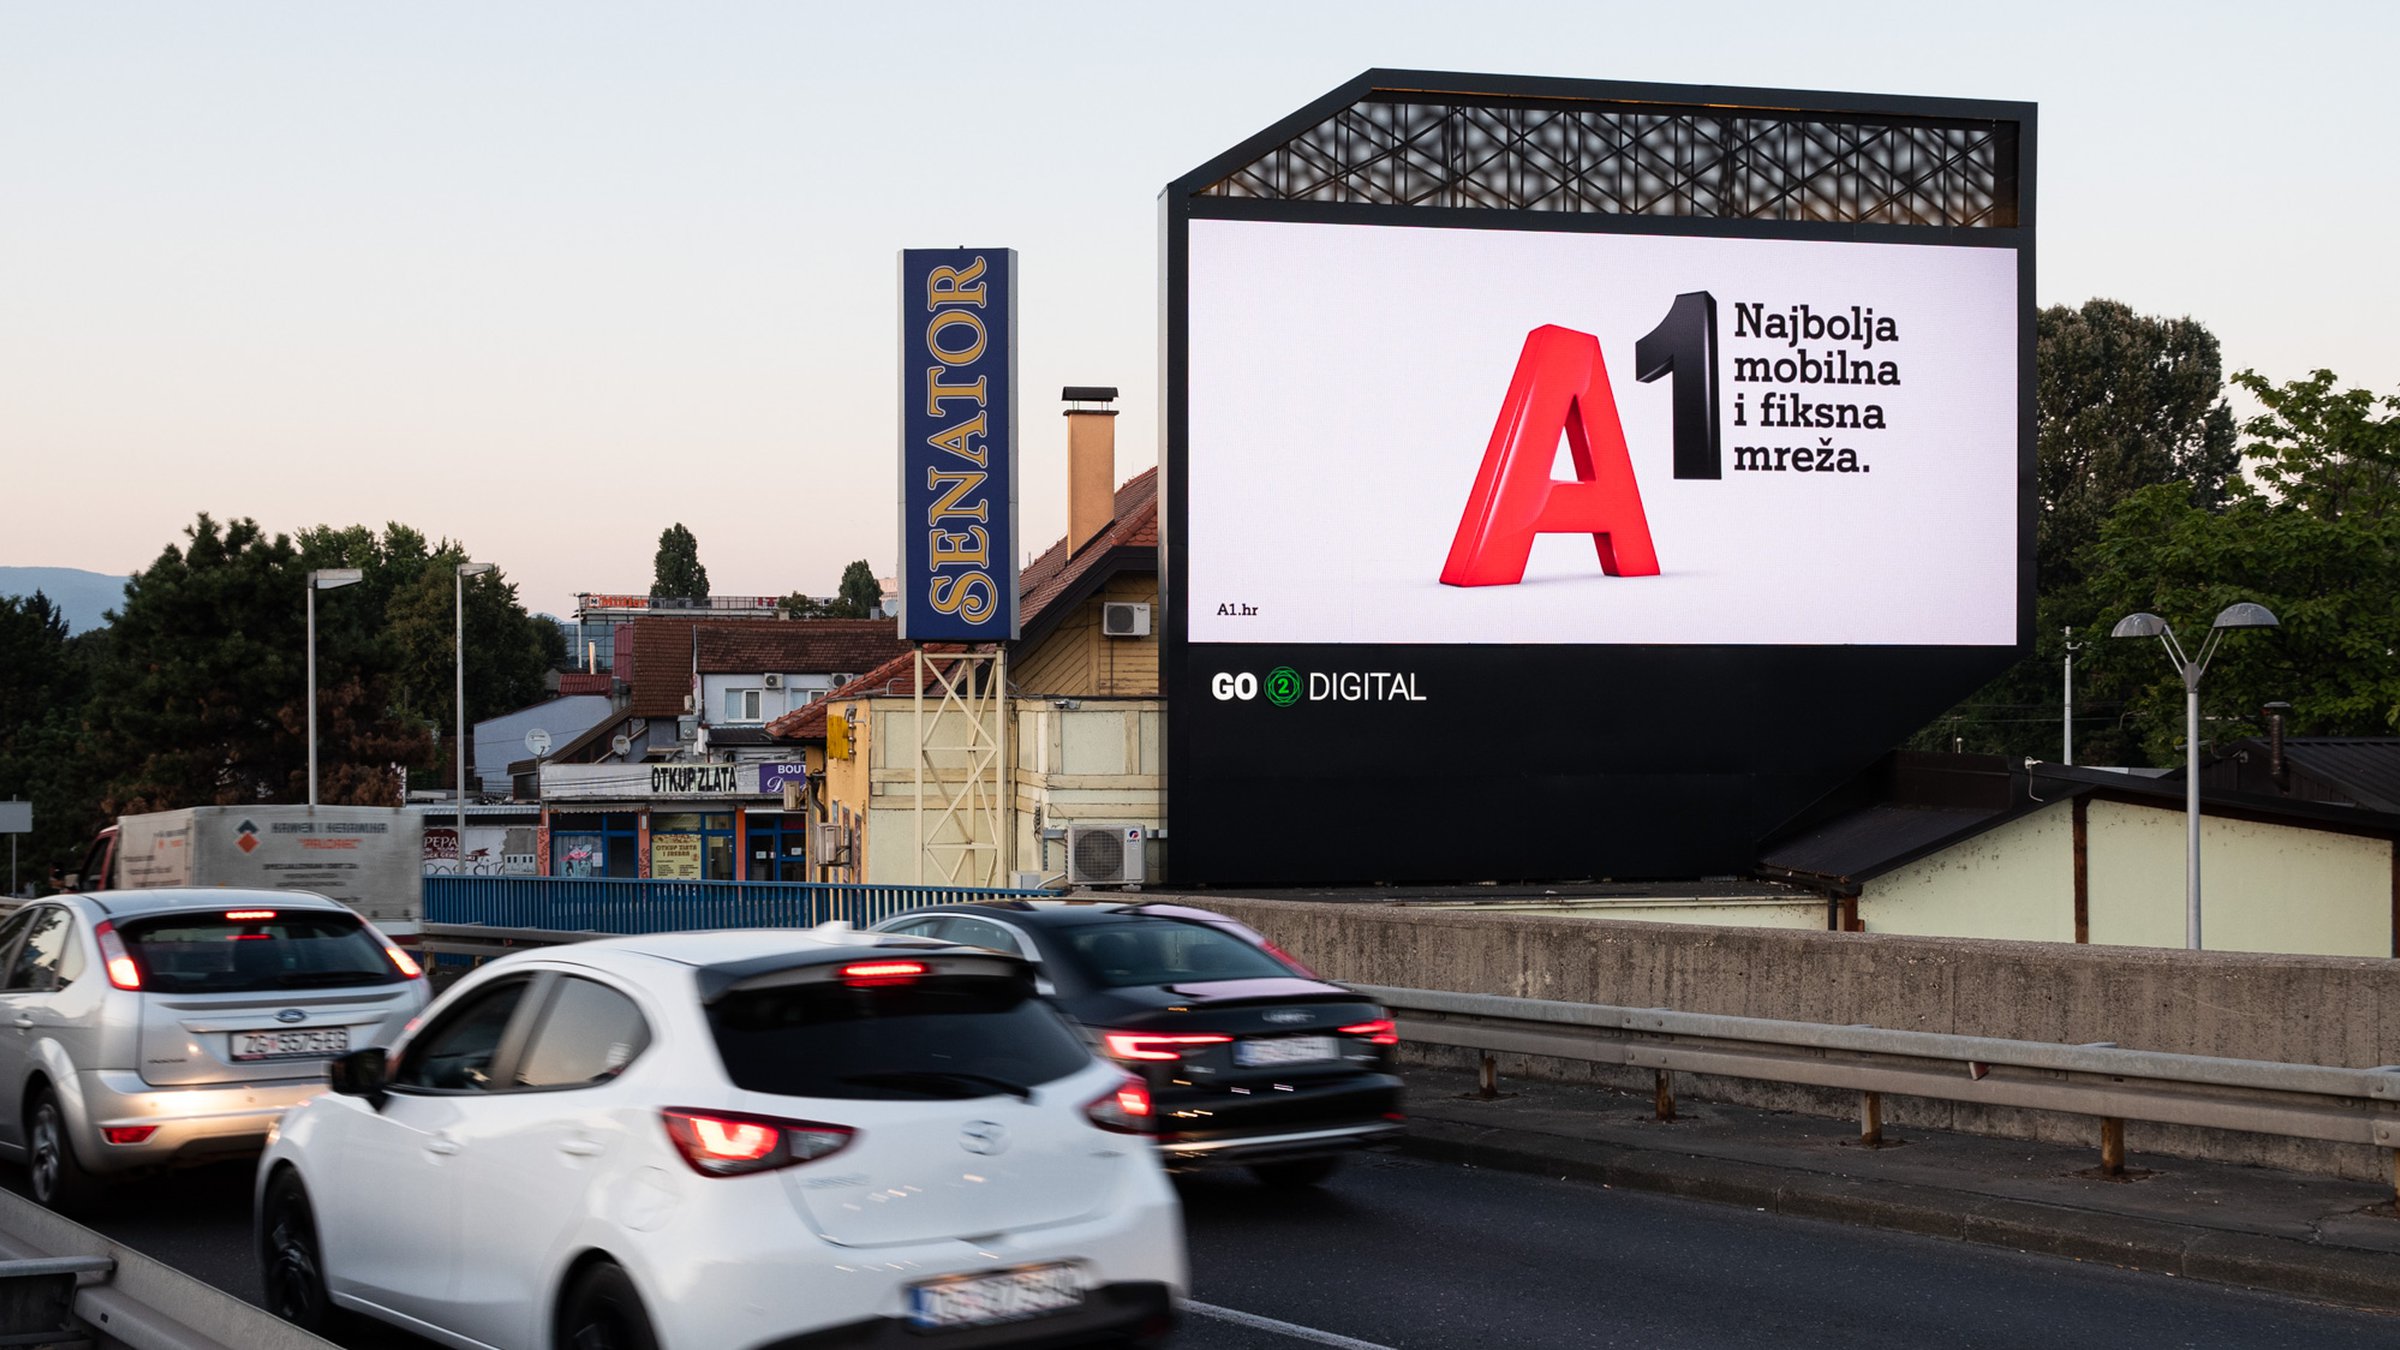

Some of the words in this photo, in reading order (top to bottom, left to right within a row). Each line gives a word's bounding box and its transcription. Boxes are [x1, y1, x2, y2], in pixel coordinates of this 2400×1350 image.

[1734, 302, 1899, 349] Najbolja
[1734, 349, 1901, 386] mobilna
[1734, 393, 1748, 427] i
[1760, 392, 1887, 430] fiksna
[927, 256, 998, 626] SENATOR
[1439, 290, 1723, 588] A1
[1734, 437, 1870, 473] mreža.
[1216, 602, 1259, 617] A1.hr
[1211, 672, 1258, 701] GO
[1309, 672, 1428, 701] DIGITAL
[652, 766, 695, 792] OTKUP
[697, 766, 738, 792] ZLATA
[424, 836, 459, 848] PEPA
